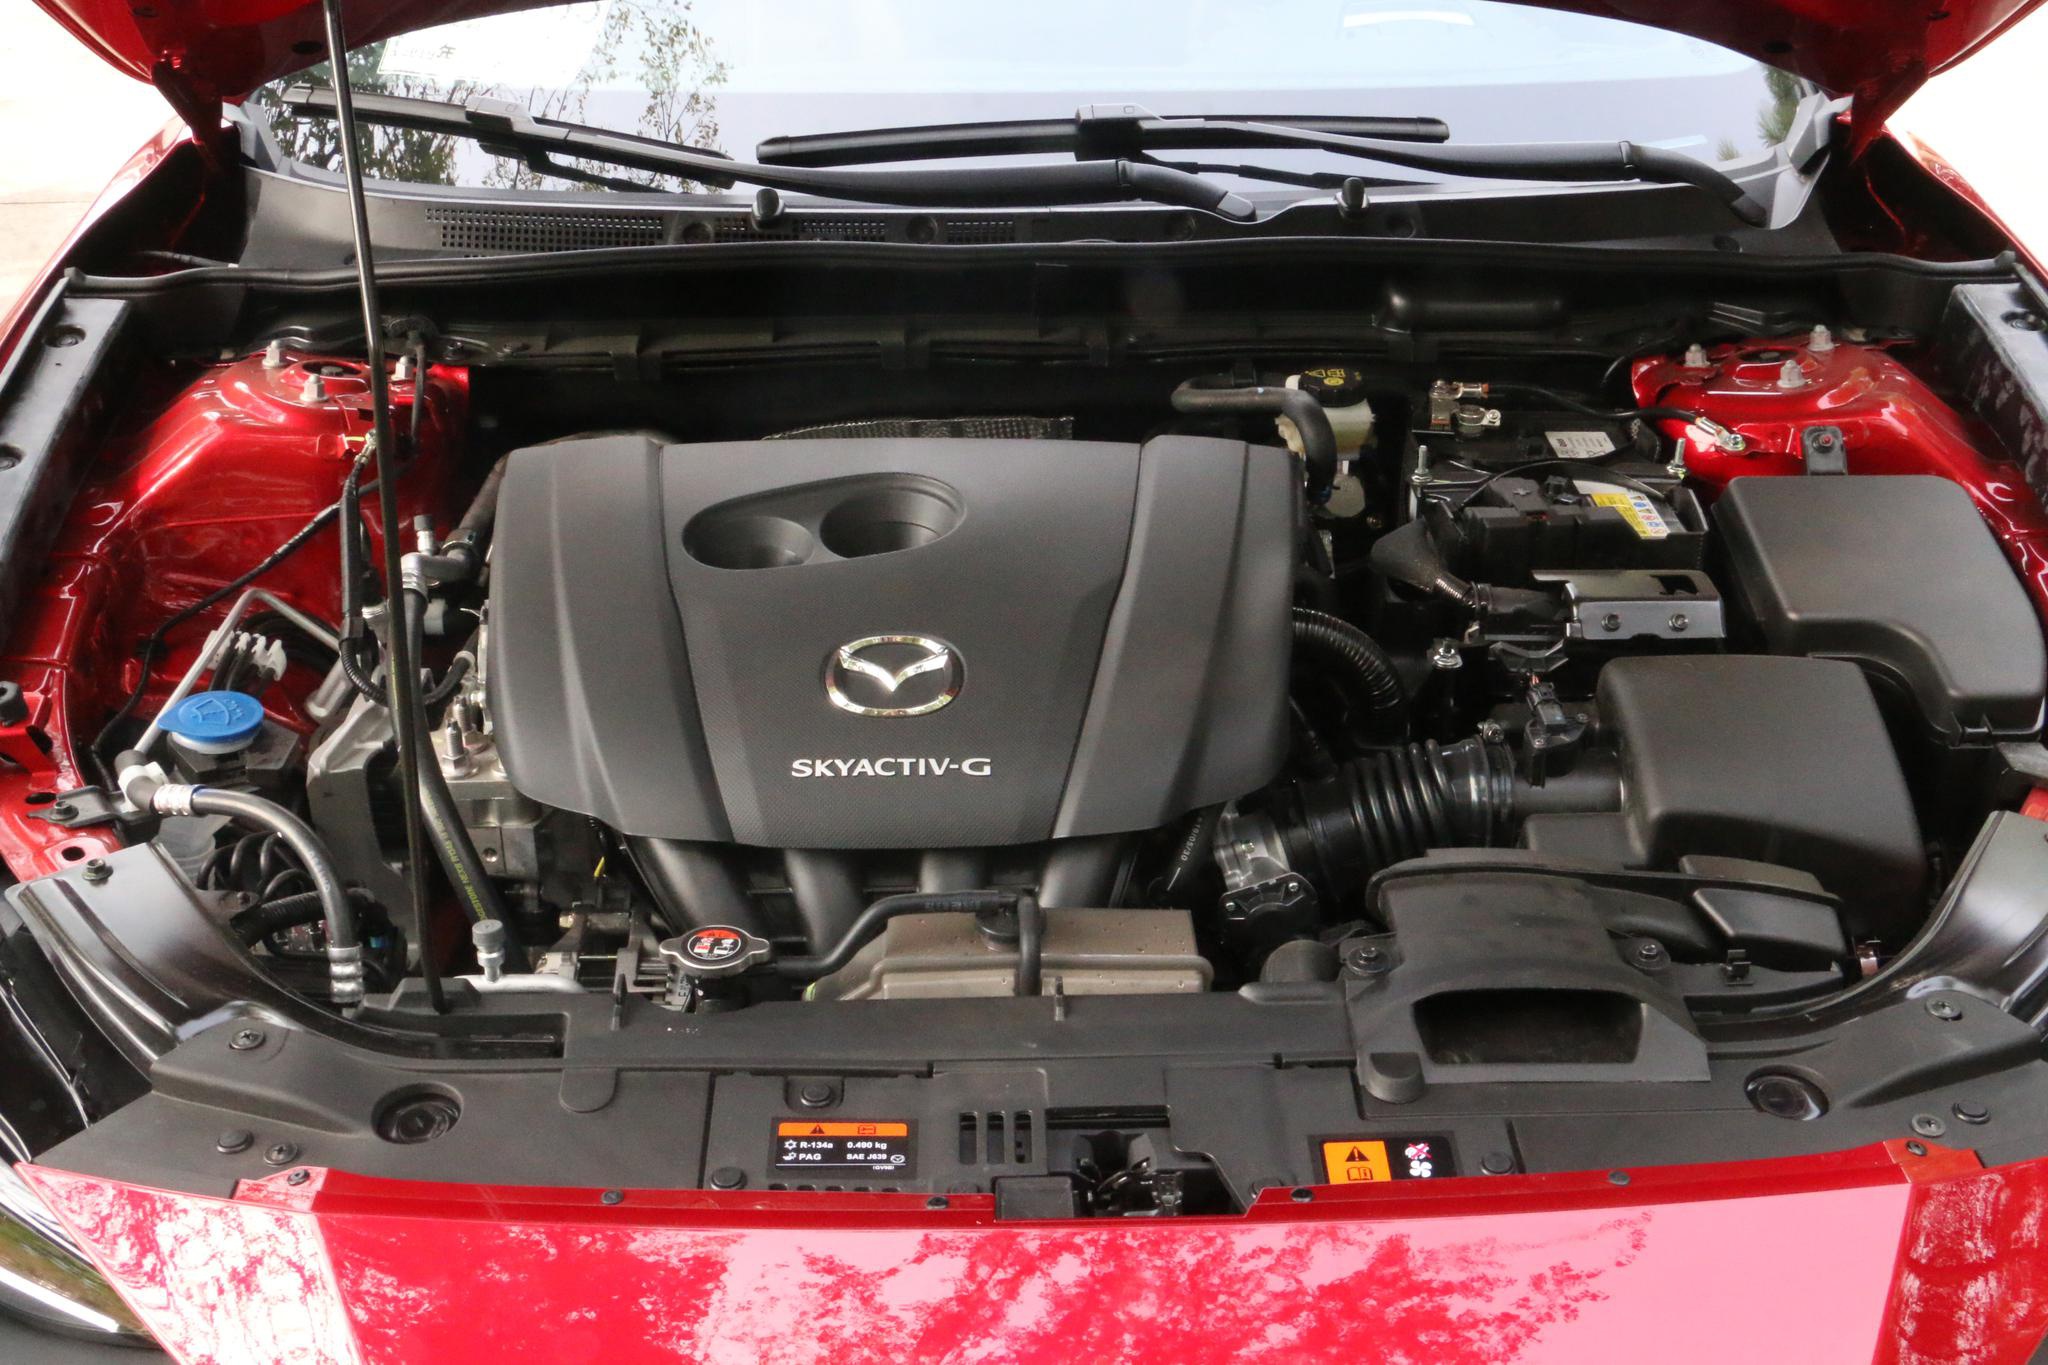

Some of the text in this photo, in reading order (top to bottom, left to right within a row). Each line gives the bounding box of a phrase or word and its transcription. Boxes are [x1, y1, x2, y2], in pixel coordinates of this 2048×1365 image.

[791, 757, 991, 777] SKYACTIV-G
[800, 1141, 888, 1150] R-134a 0.490 kg
[798, 1153, 822, 1161] PAG
